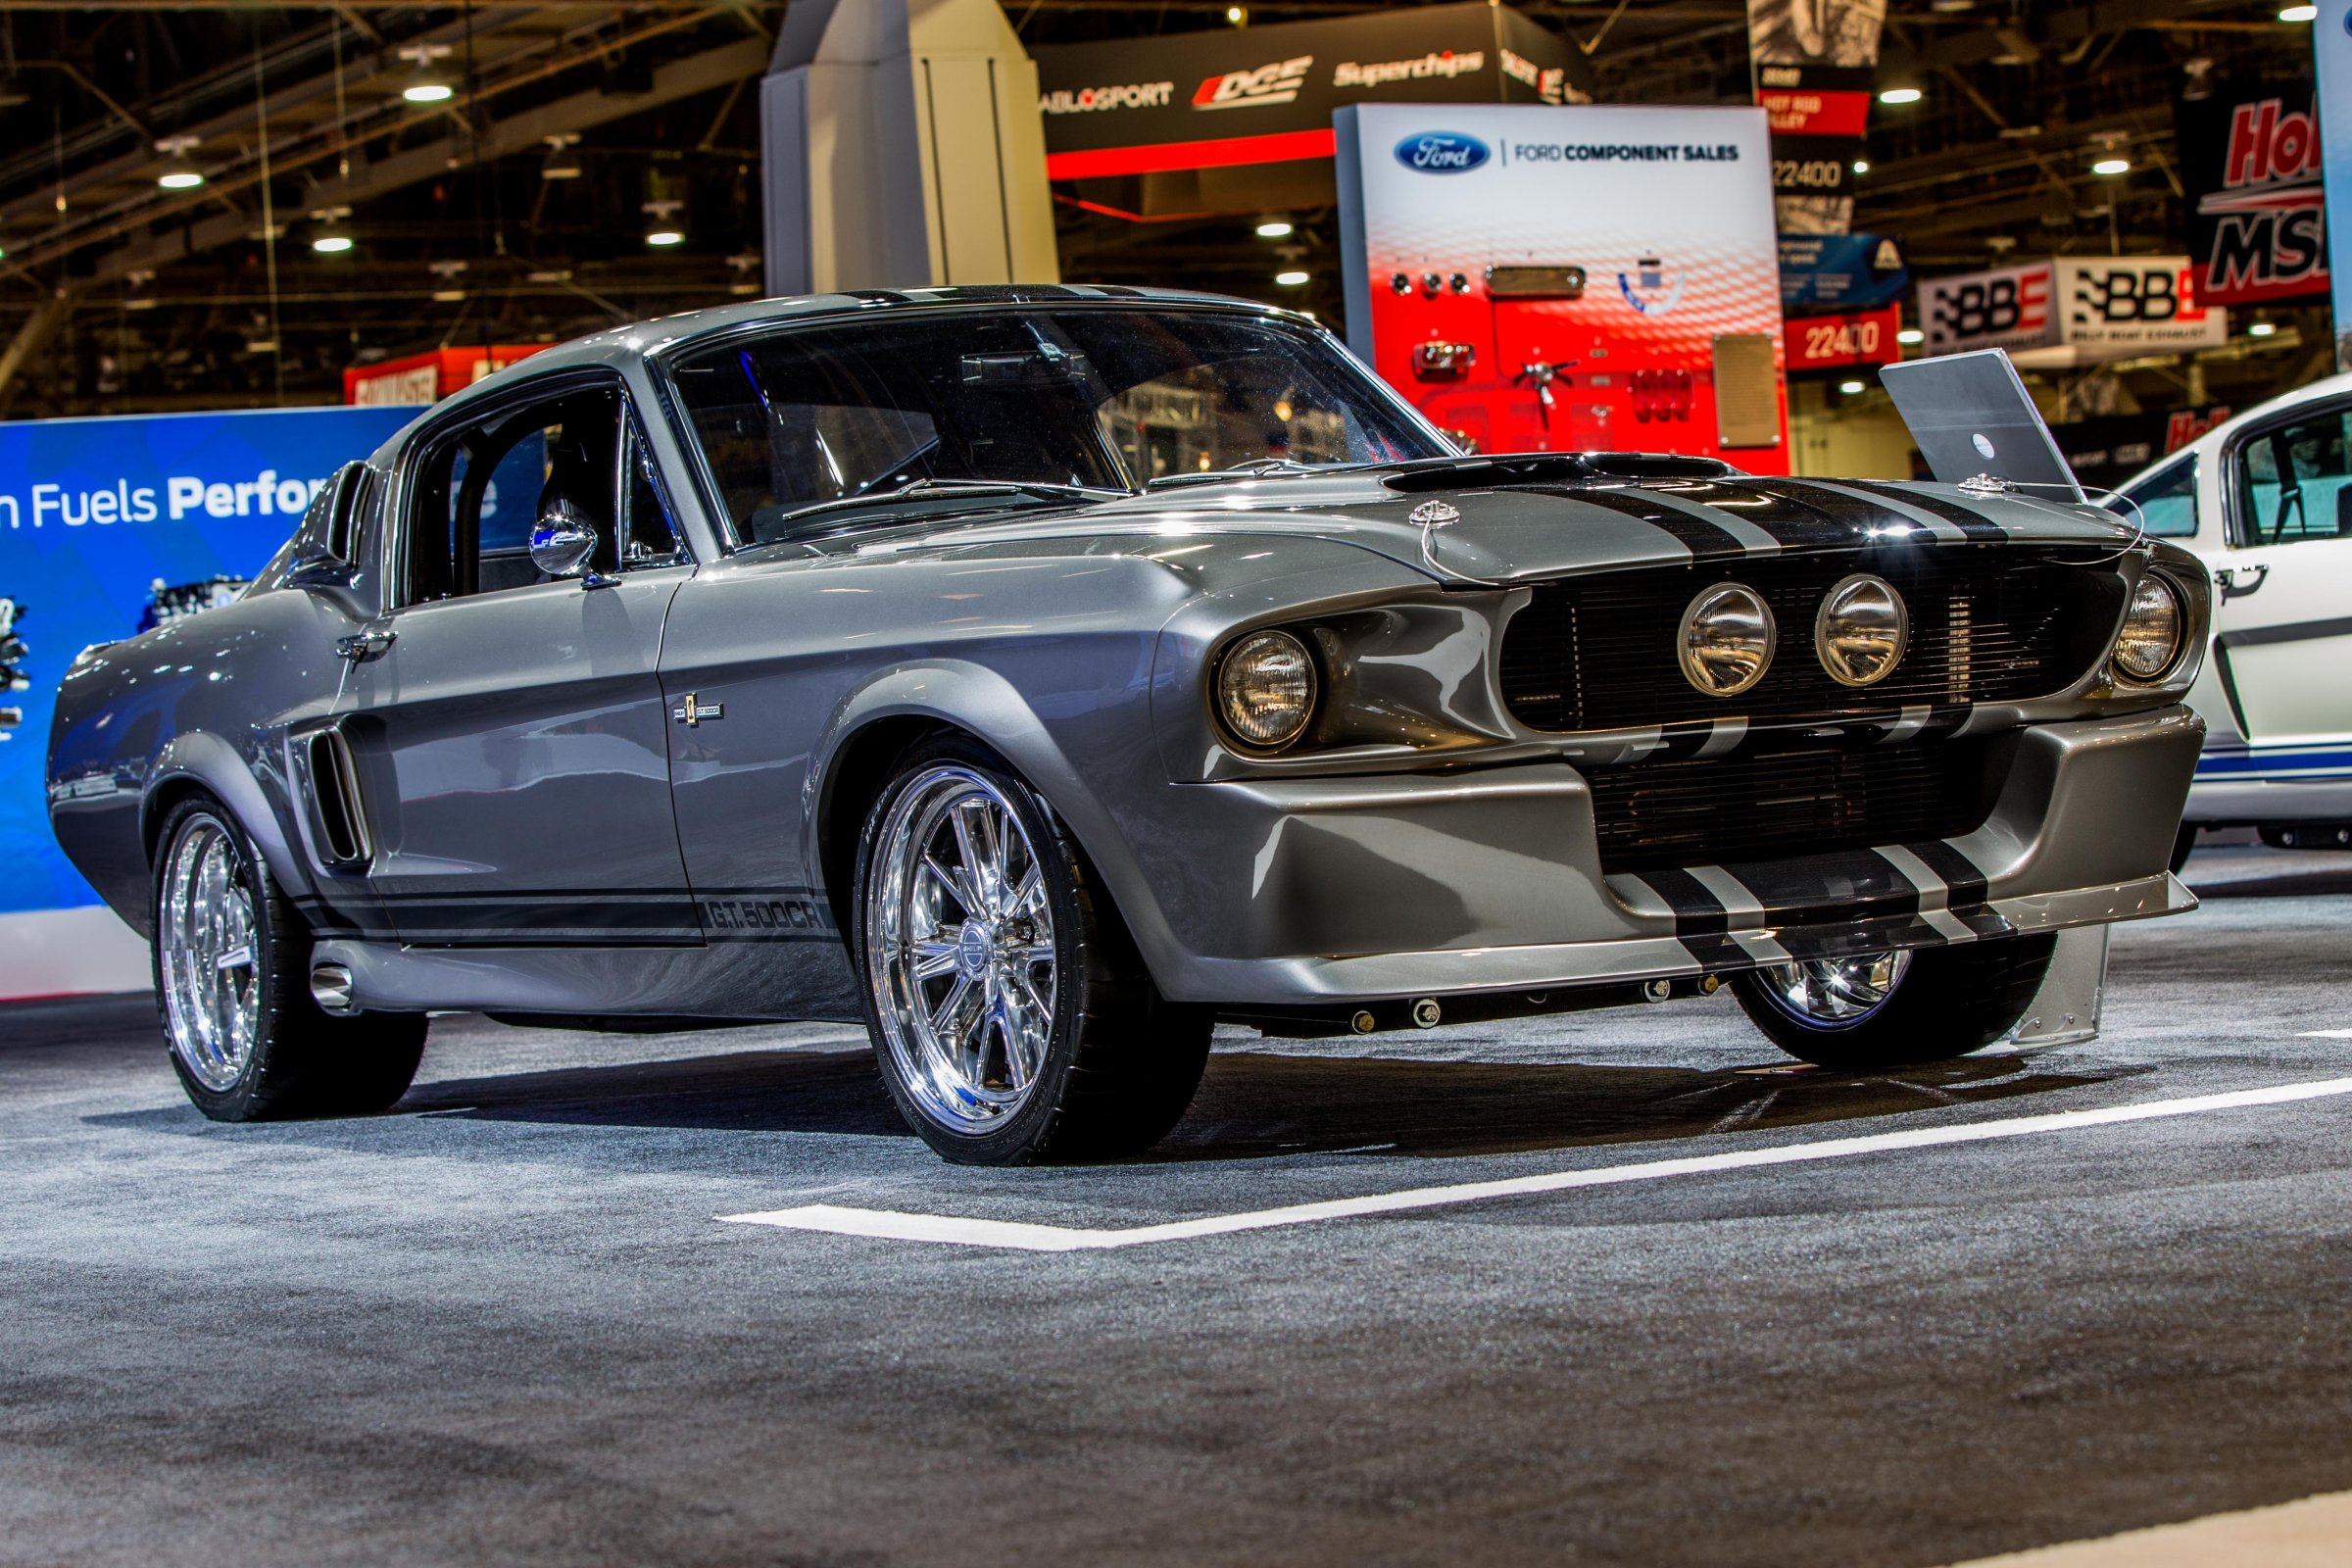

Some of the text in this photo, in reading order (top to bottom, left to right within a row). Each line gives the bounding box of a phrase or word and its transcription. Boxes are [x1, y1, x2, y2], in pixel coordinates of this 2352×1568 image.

[1333, 50, 1485, 87] Superchips
[1413, 135, 1471, 169] Ford
[1515, 144, 1740, 162] FORD COMPONENT SALES
[2205, 203, 2329, 292] MS
[1956, 269, 2049, 339] BBE
[1804, 320, 1881, 360] 22400
[32, 478, 158, 528] Fuels
